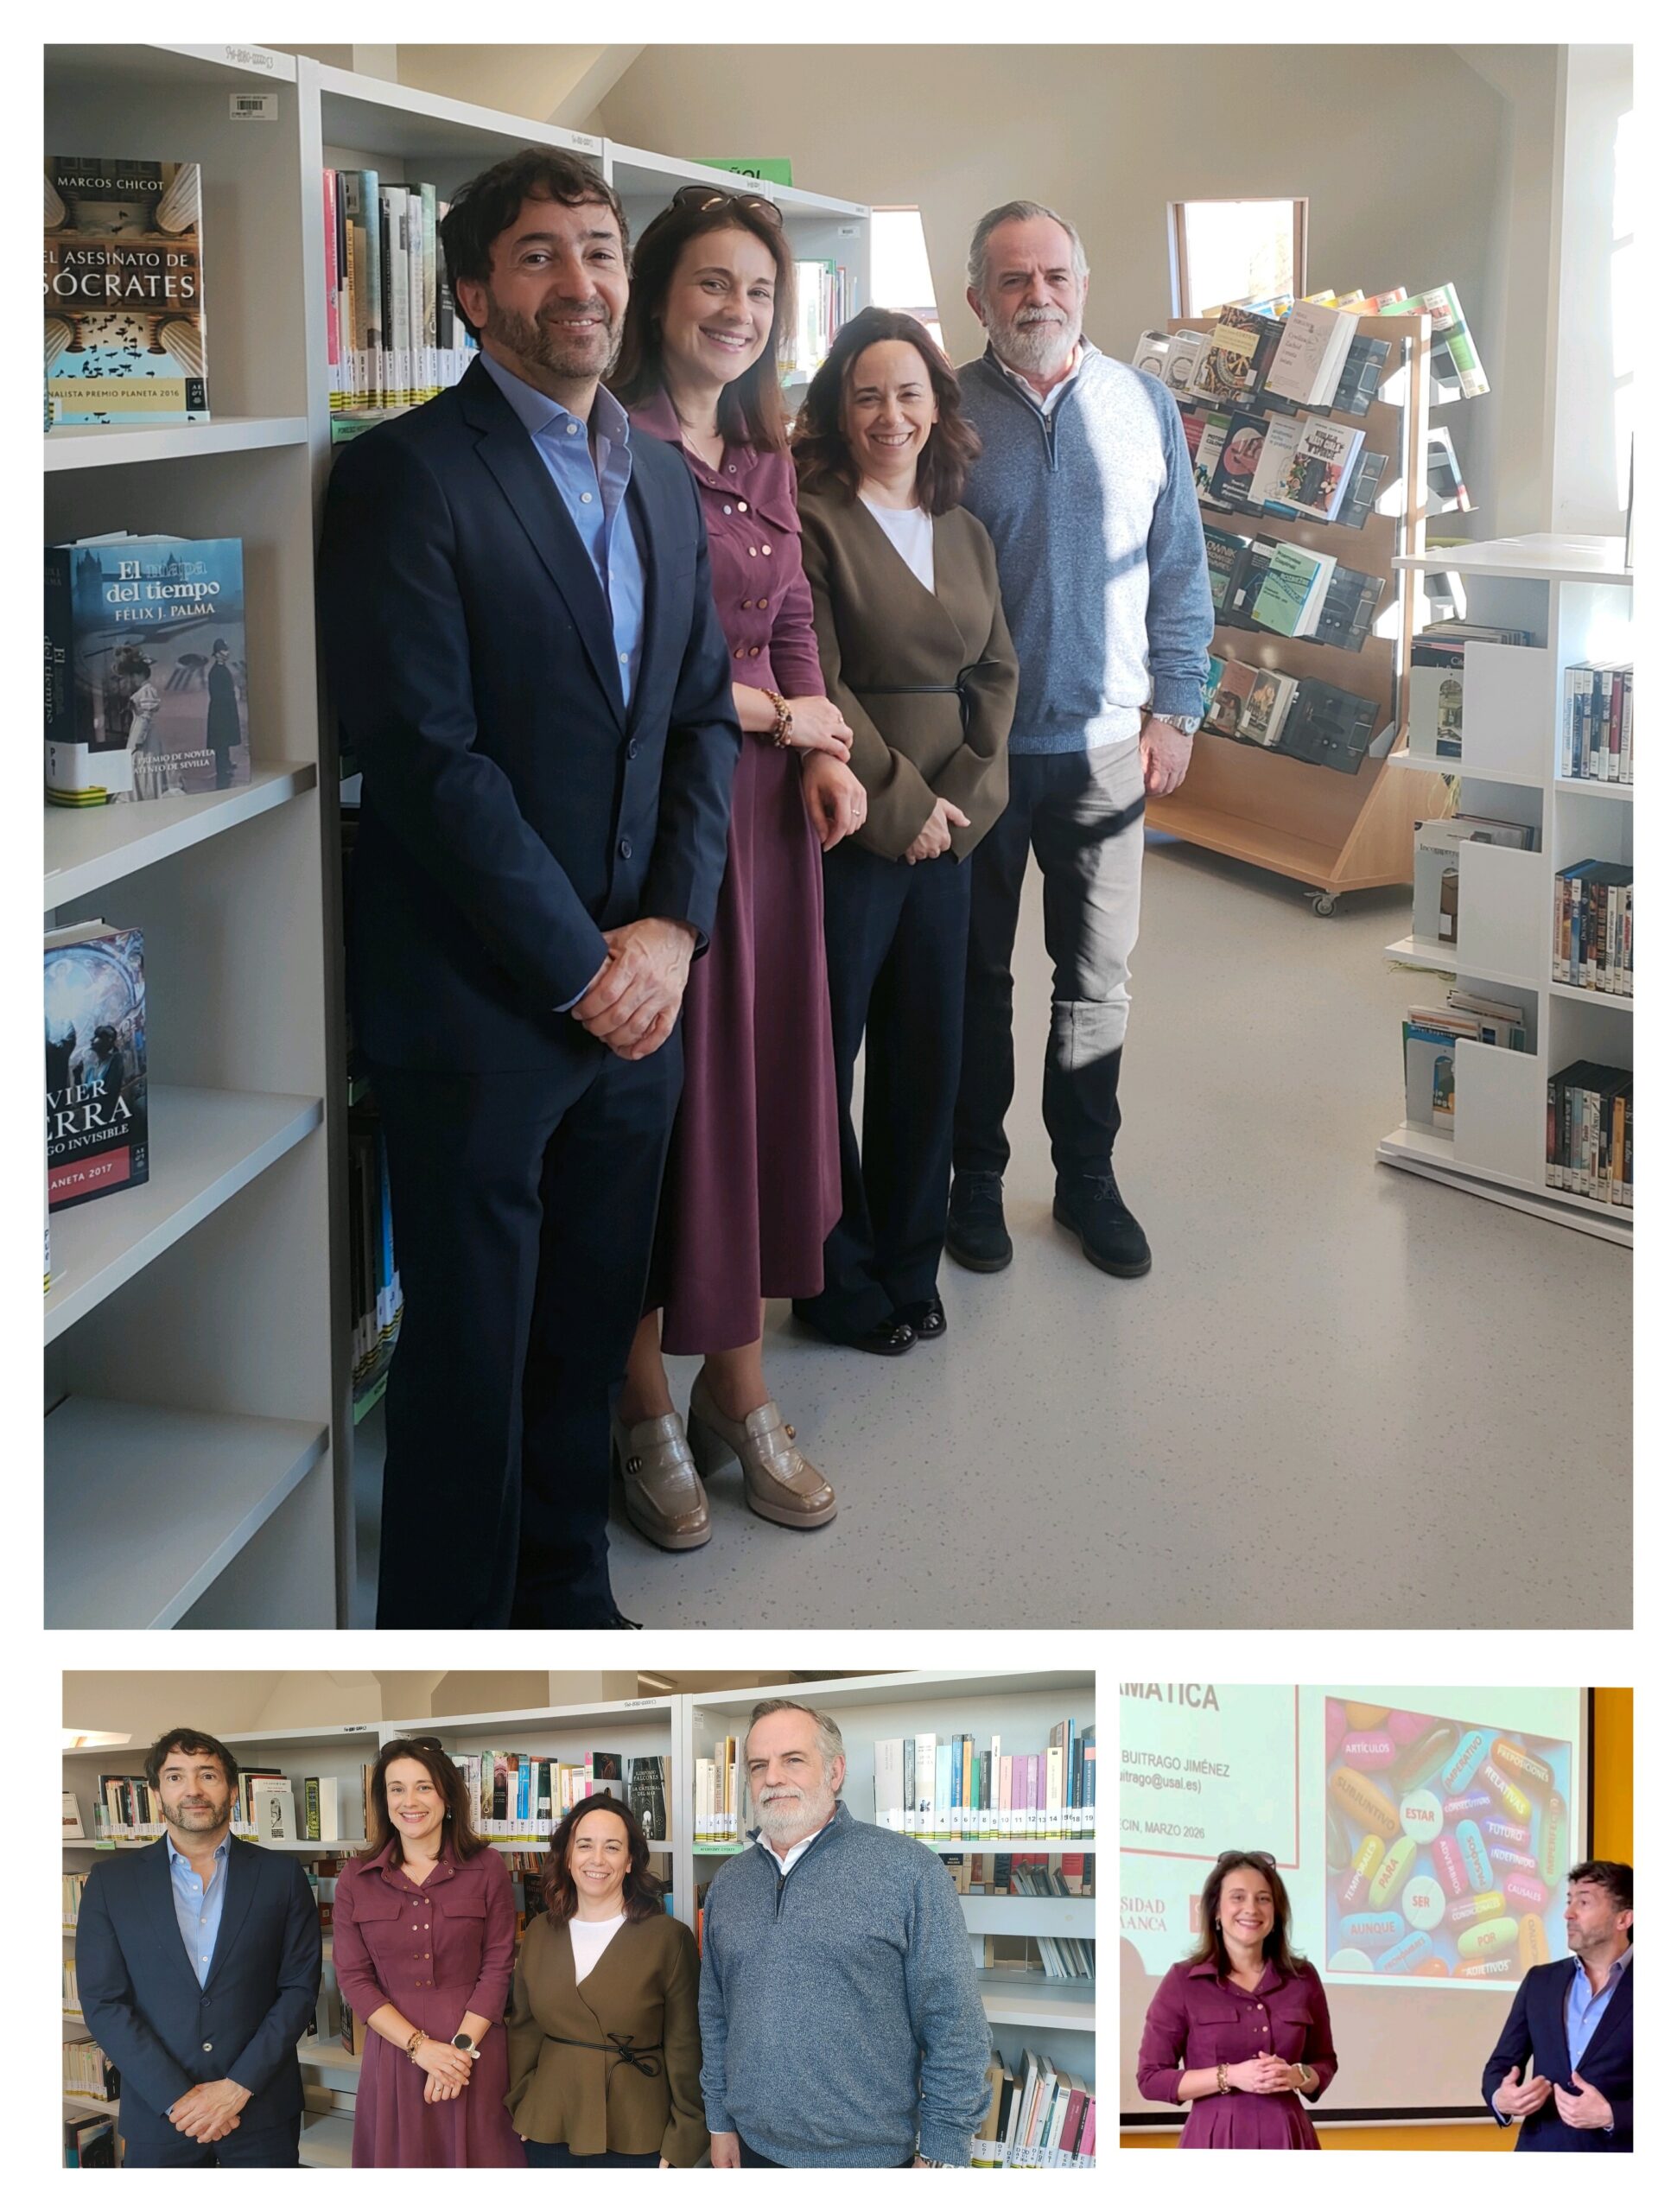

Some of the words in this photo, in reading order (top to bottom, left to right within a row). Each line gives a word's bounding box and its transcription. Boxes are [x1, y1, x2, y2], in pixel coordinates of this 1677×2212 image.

[57, 176, 111, 188] MARCOS
[116, 180, 165, 191] CHICOT
[64, 251, 160, 267] ASESINATO
[167, 254, 188, 267] DE
[118, 560, 143, 581] El
[146, 559, 208, 582] mapa
[106, 582, 140, 604] del
[144, 579, 221, 603] tiempo
[114, 604, 155, 622] FÉLIX
[157, 607, 168, 621] J.
[170, 602, 216, 619] PALMA
[180, 759, 210, 769] SEVILLA
[184, 748, 215, 760] NOVELA
[47, 1078, 108, 1109] VIER
[68, 1123, 129, 1151] INVISIBLE
[48, 1172, 85, 1190] ANETA
[89, 1163, 112, 1178] 2017
[1345, 1740, 1390, 1754] ARTÍCULOS
[1121, 1750, 1181, 1770] BUITRAGO
[1183, 1758, 1230, 1777] JIMÉNEZ
[1444, 1735, 1483, 1787] IMPERATIVO
[1496, 1744, 1550, 1783] PREPOSICIONES
[1484, 1765, 1527, 1815] RELATIVAS
[1336, 1775, 1396, 1832] SUBJUNTIVO
[1405, 1807, 1435, 1822] ESTAR
[1145, 1821, 1182, 1837] MARZO
[1184, 1826, 1205, 1840] 2026
[1488, 1821, 1524, 1841] FUTURO
[1439, 1840, 1462, 1895] ADVERBIOS
[1490, 1847, 1535, 1869] INDEFINIDO
[1344, 1840, 1376, 1901] TEMPORALES
[1378, 1858, 1399, 1889] PARA
[1411, 1894, 1431, 1908] SER
[1507, 1883, 1541, 1903] CAUSALES
[1350, 1921, 1395, 1936] AUNQUE
[1477, 1933, 1496, 1947] POR
